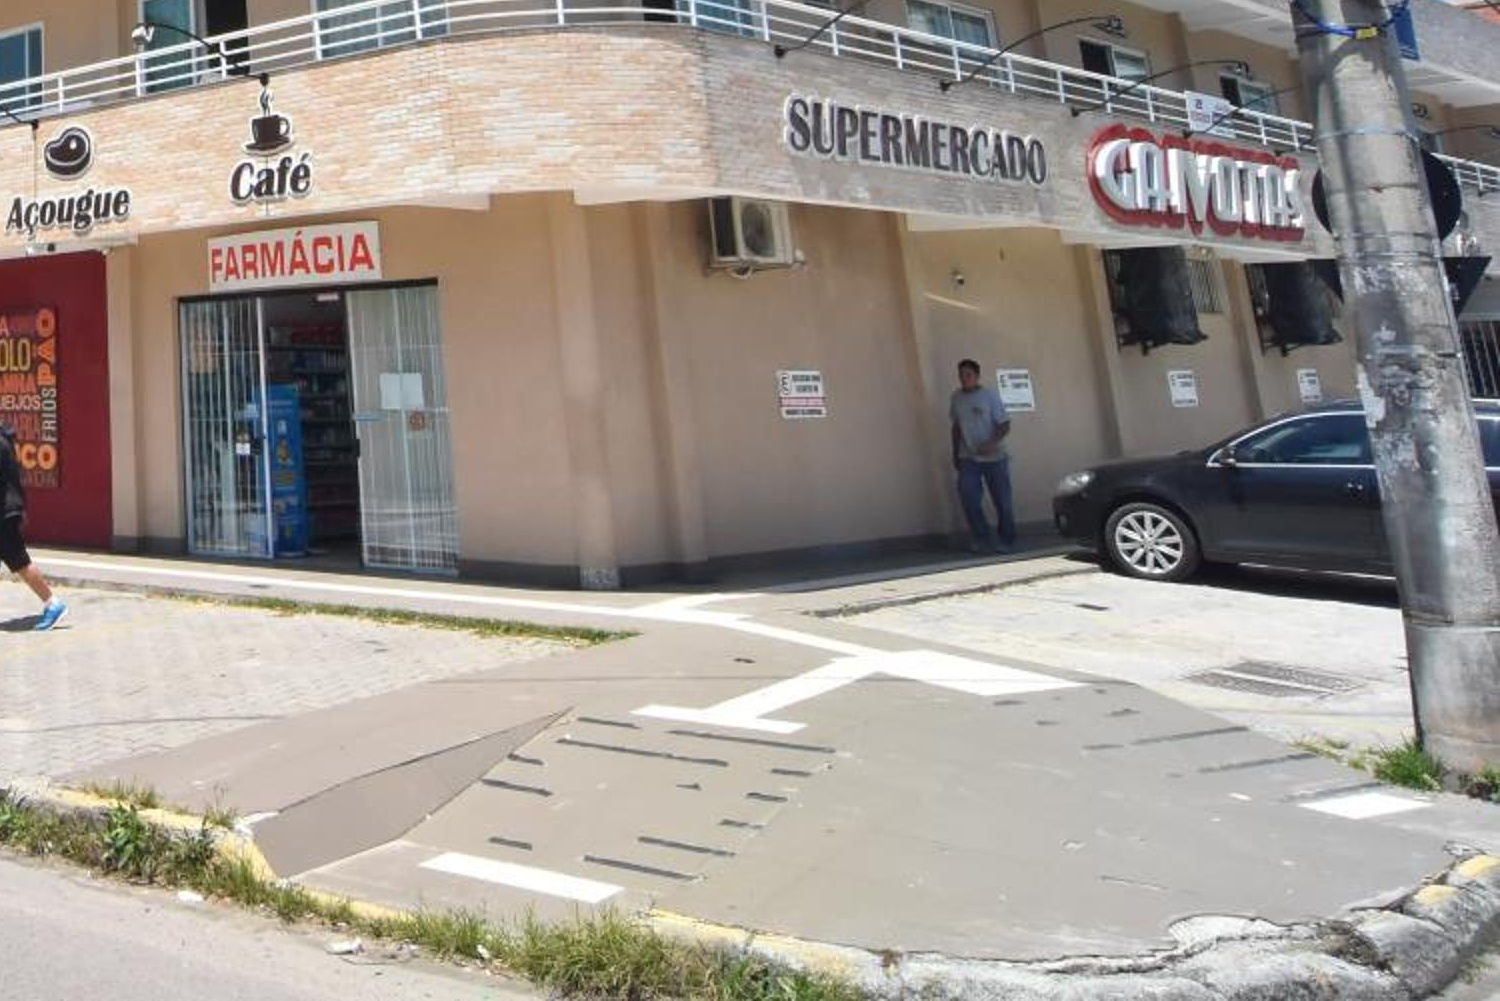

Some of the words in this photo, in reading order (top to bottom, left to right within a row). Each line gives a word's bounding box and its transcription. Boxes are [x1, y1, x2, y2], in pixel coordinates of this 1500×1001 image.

[231, 153, 311, 201] Café
[786, 97, 1047, 186] SUPERMERCADO
[1094, 137, 1303, 230] GAIVOTAS
[6, 188, 130, 236] Açougue
[211, 231, 375, 283] FARMÁCIA
[40, 387, 57, 442] FRIOS
